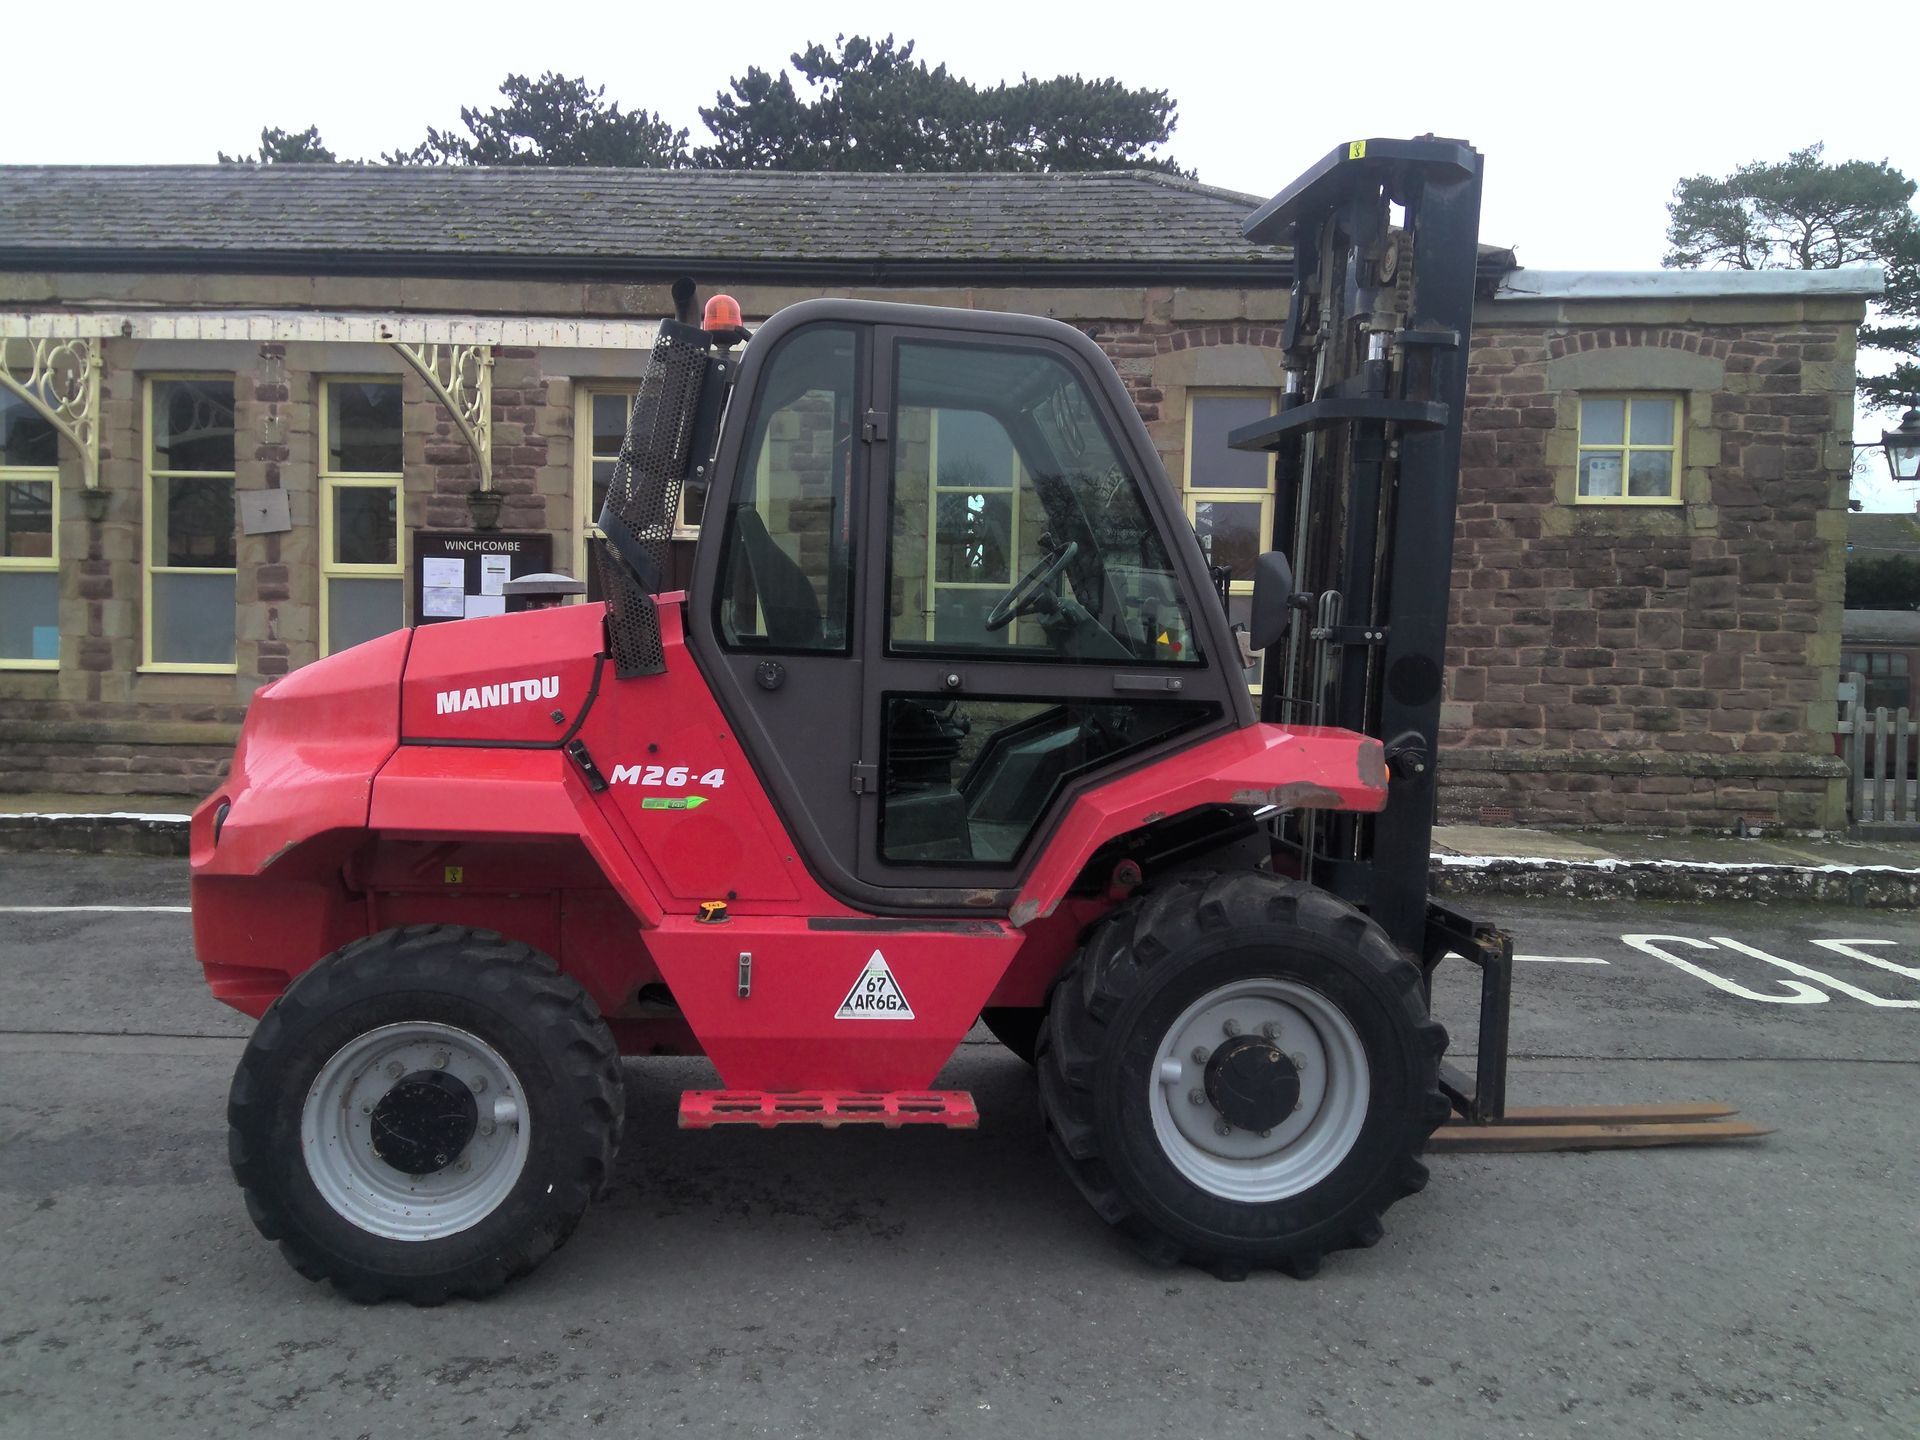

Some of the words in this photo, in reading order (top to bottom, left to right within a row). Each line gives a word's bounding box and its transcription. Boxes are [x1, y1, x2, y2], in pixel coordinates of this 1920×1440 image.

[445, 541, 521, 551] WINCHCOMBE
[437, 676, 559, 715] MANITOU
[610, 764, 725, 788] M26-4
[866, 977, 887, 993] 67
[854, 994, 897, 1010] AR6G
